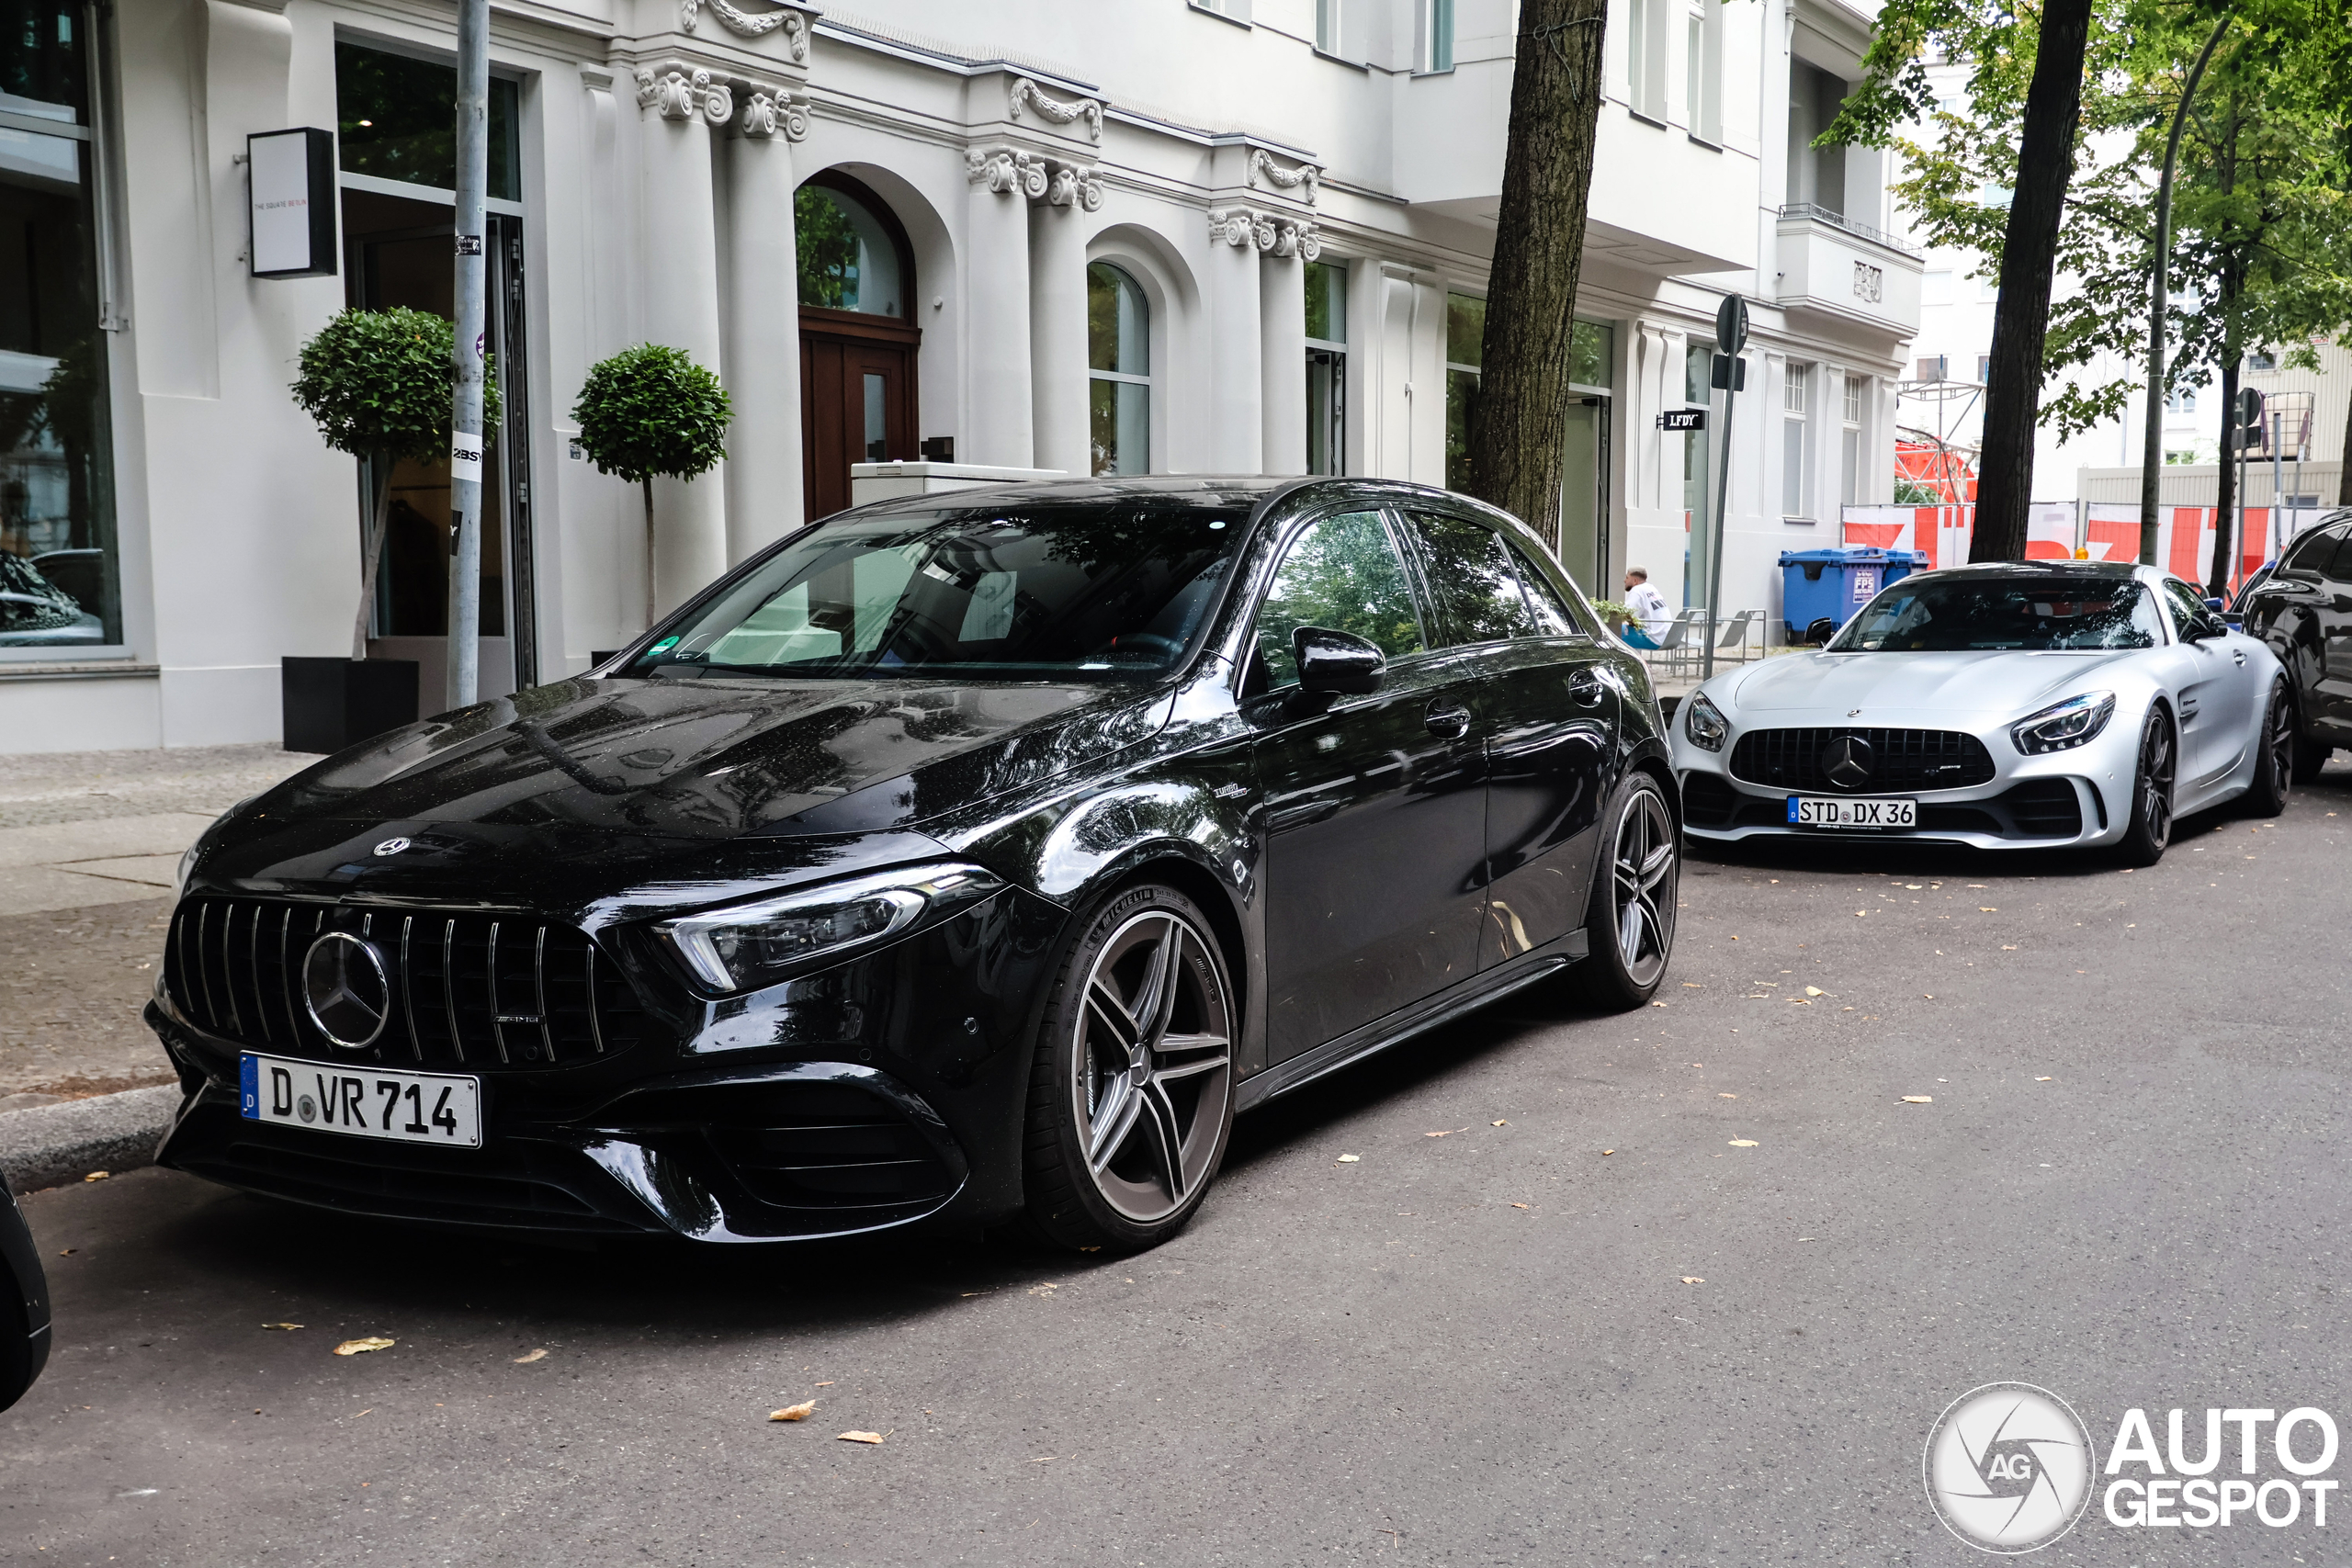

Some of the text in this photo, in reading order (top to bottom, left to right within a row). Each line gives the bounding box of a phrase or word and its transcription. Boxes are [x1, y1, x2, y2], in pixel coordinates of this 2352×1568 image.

[288, 198, 307, 207] BERLIN
[1668, 413, 1696, 427] LFDY
[1855, 579, 1873, 589] FPS
[1212, 783, 1238, 797] TURBO
[1800, 802, 1913, 824] STD DX 36
[1102, 889, 1152, 928] MICHELIN
[1086, 1042, 1094, 1098] AMG
[246, 1093, 254, 1108] D
[271, 1066, 458, 1136] D VR 714
